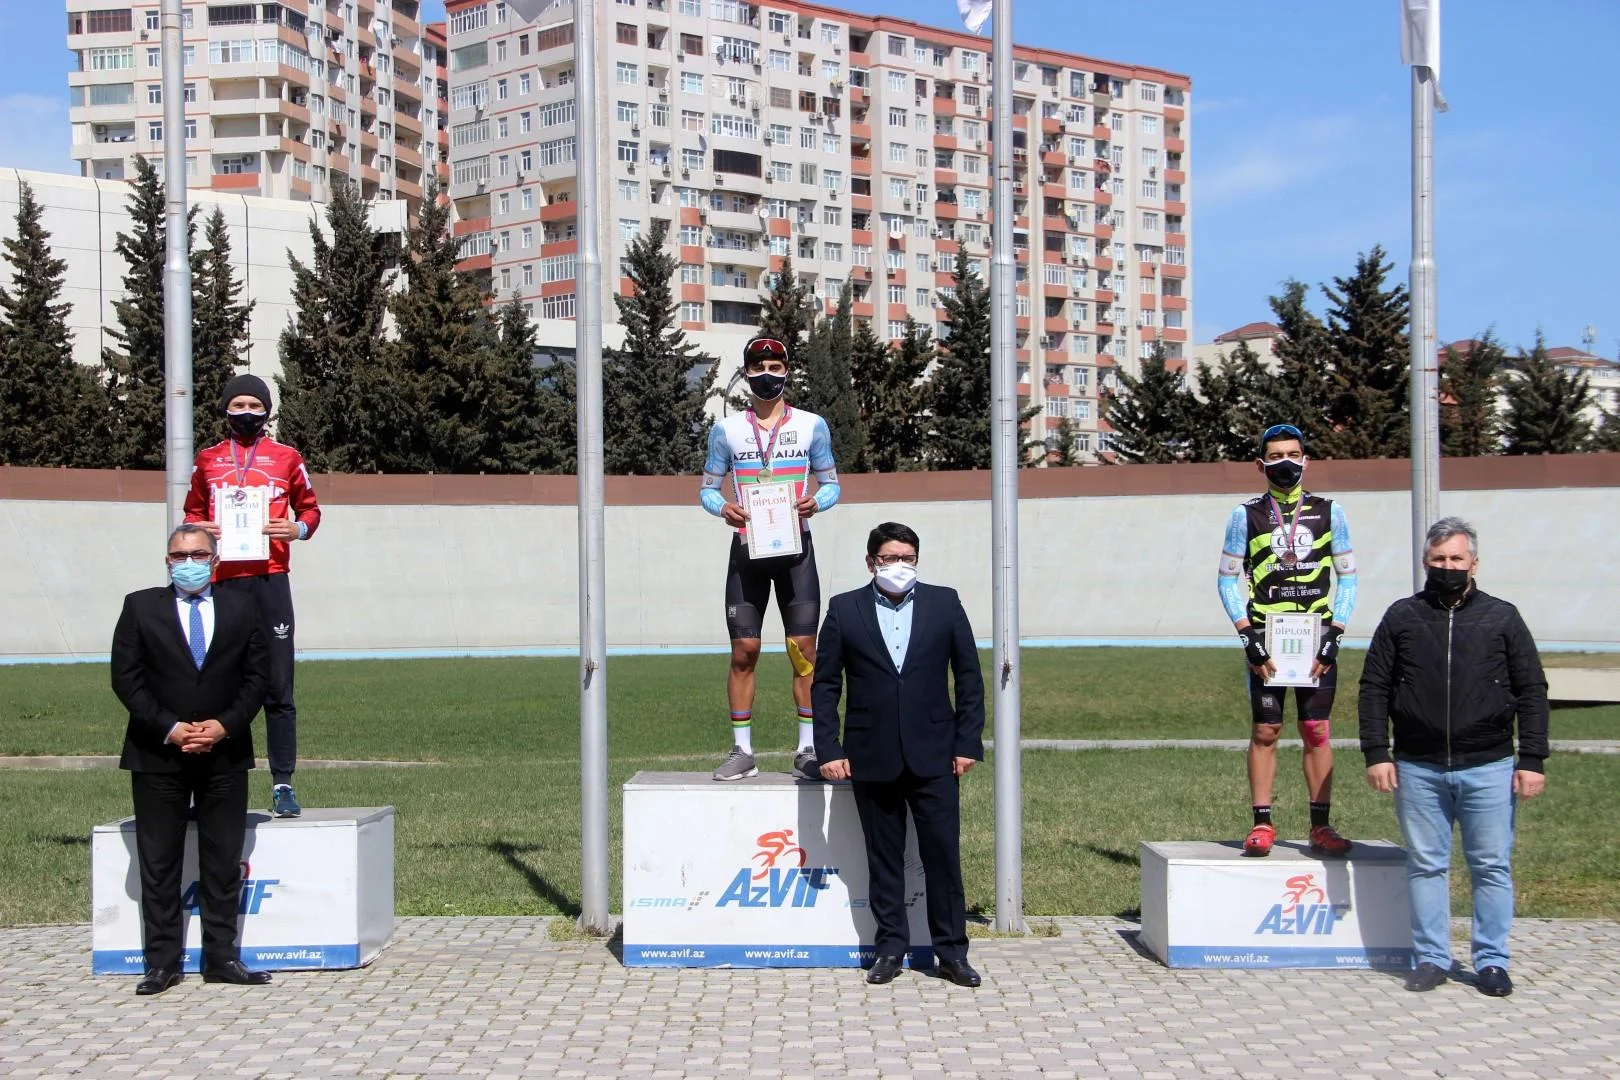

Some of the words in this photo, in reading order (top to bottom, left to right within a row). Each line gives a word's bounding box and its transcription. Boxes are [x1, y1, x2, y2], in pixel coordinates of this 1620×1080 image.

[733, 448, 808, 461] AZERAIJAN
[235, 513, 249, 528] II
[1281, 639, 1304, 655] III
[256, 950, 322, 961] www.avif.az
[641, 949, 705, 959] www.avif.az
[745, 949, 809, 959] www.avif.az
[1203, 953, 1270, 964] www.avif.az
